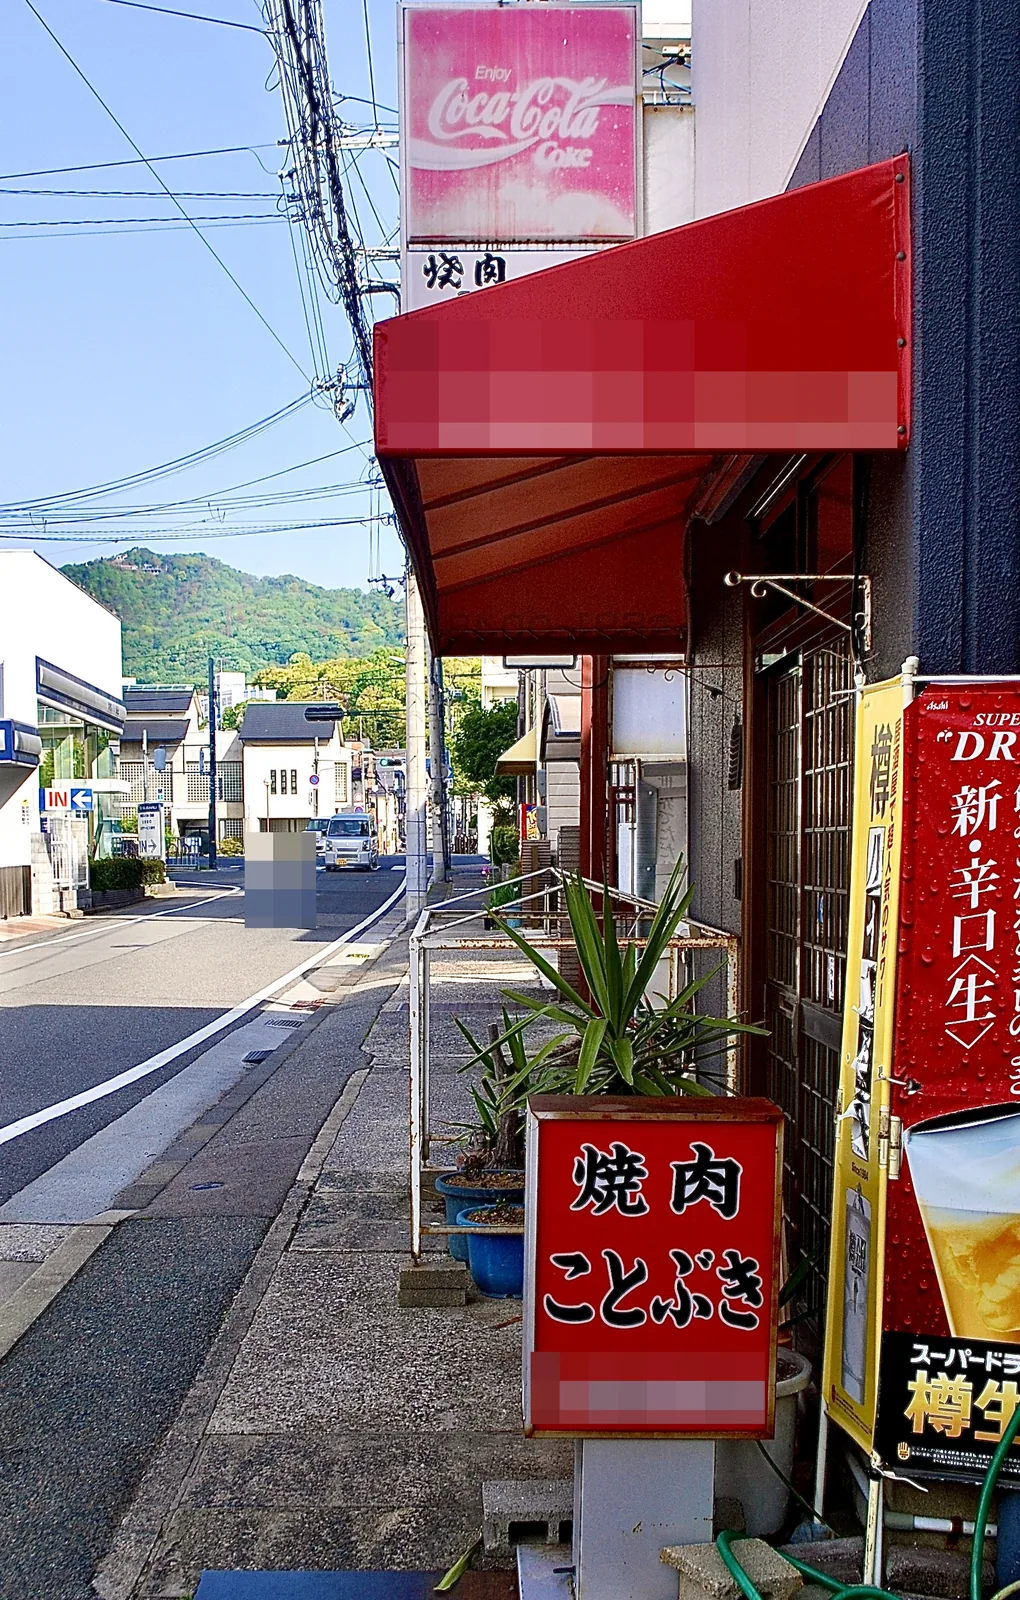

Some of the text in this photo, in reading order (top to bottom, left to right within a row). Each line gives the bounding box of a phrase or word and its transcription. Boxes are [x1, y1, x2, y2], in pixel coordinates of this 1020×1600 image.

[475, 65, 512, 82] Enjoy
[533, 141, 594, 169] Coke
[422, 252, 507, 290] 焼肉
[926, 701, 949, 711] Asahi
[48, 791, 68, 807] IN
[569, 1141, 743, 1220] 焼肉
[543, 1248, 763, 1330] ことぶき
[910, 1343, 1020, 1374] スーパードラ
